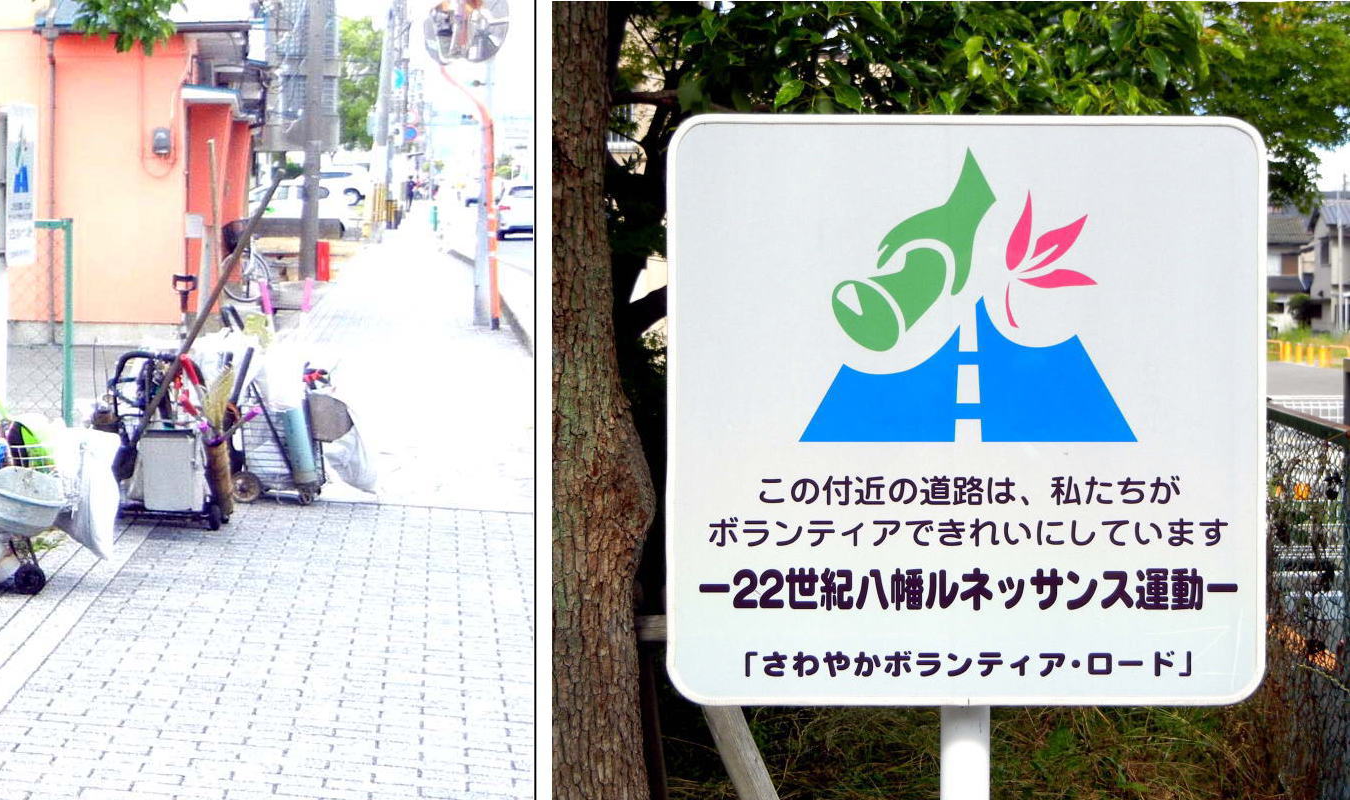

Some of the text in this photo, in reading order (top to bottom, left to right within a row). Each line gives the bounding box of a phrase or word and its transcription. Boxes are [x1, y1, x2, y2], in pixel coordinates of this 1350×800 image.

[759, 475, 1181, 506] この付近の道路は、私たちが
[708, 516, 1229, 548] ボランティアできれいにしています
